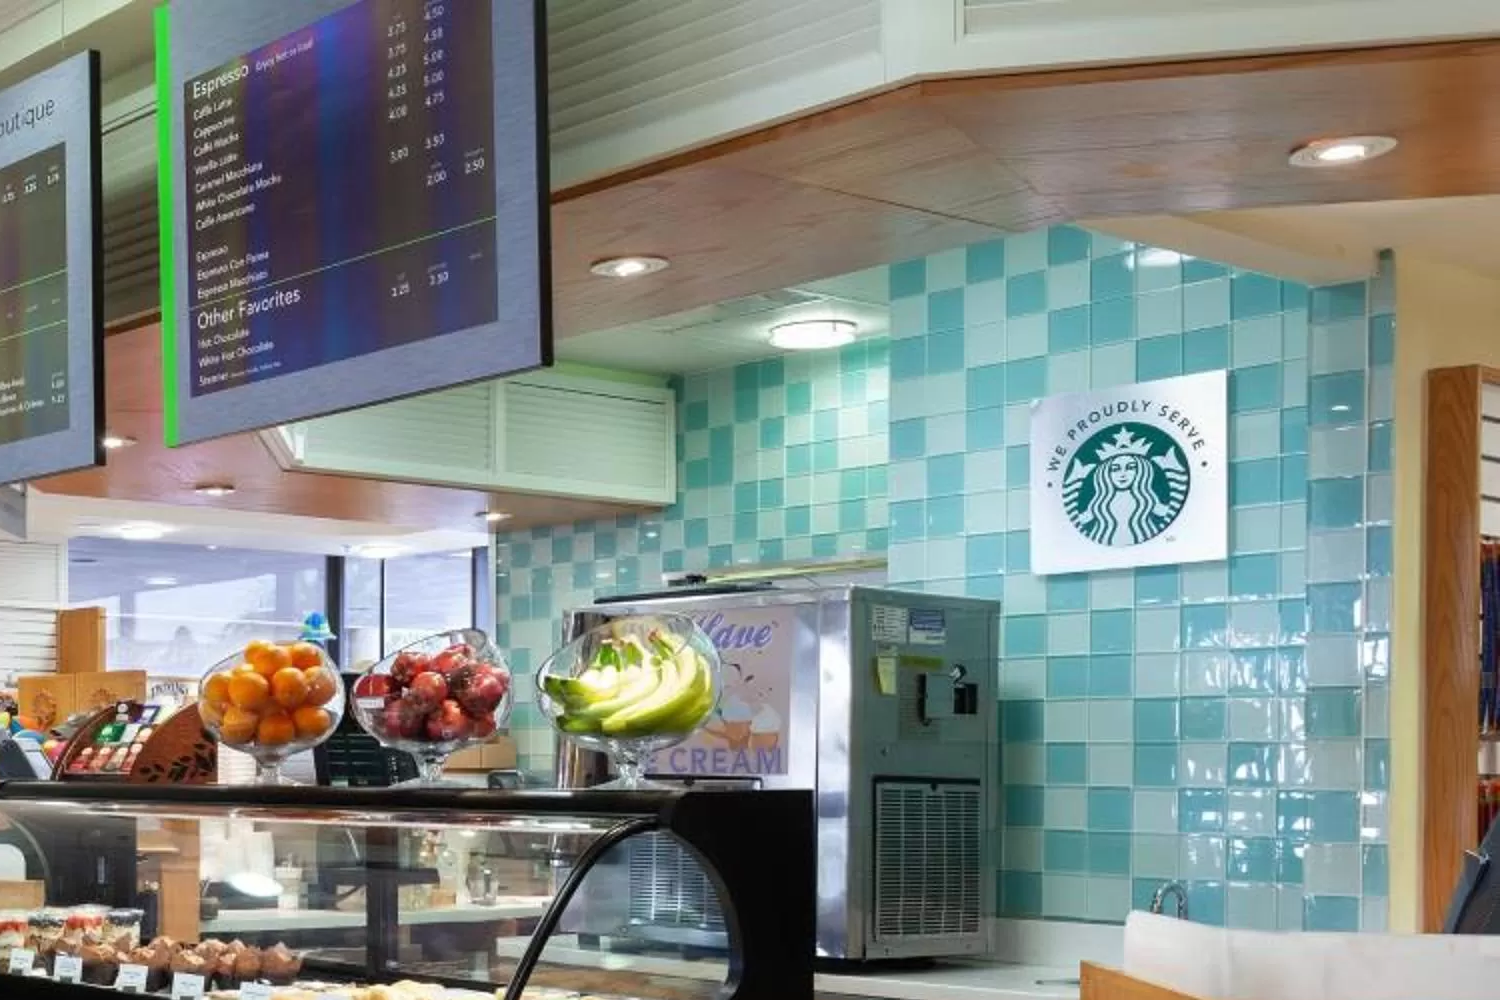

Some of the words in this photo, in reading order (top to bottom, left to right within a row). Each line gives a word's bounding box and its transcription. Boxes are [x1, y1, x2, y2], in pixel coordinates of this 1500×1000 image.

[193, 65, 249, 99] Espresso
[197, 307, 235, 329] Other
[238, 289, 301, 319] Favorites
[1048, 444, 1067, 472] WE
[1068, 400, 1152, 441] PROUDLY
[1158, 405, 1205, 452] SERVE
[670, 748, 781, 774] CREAM
